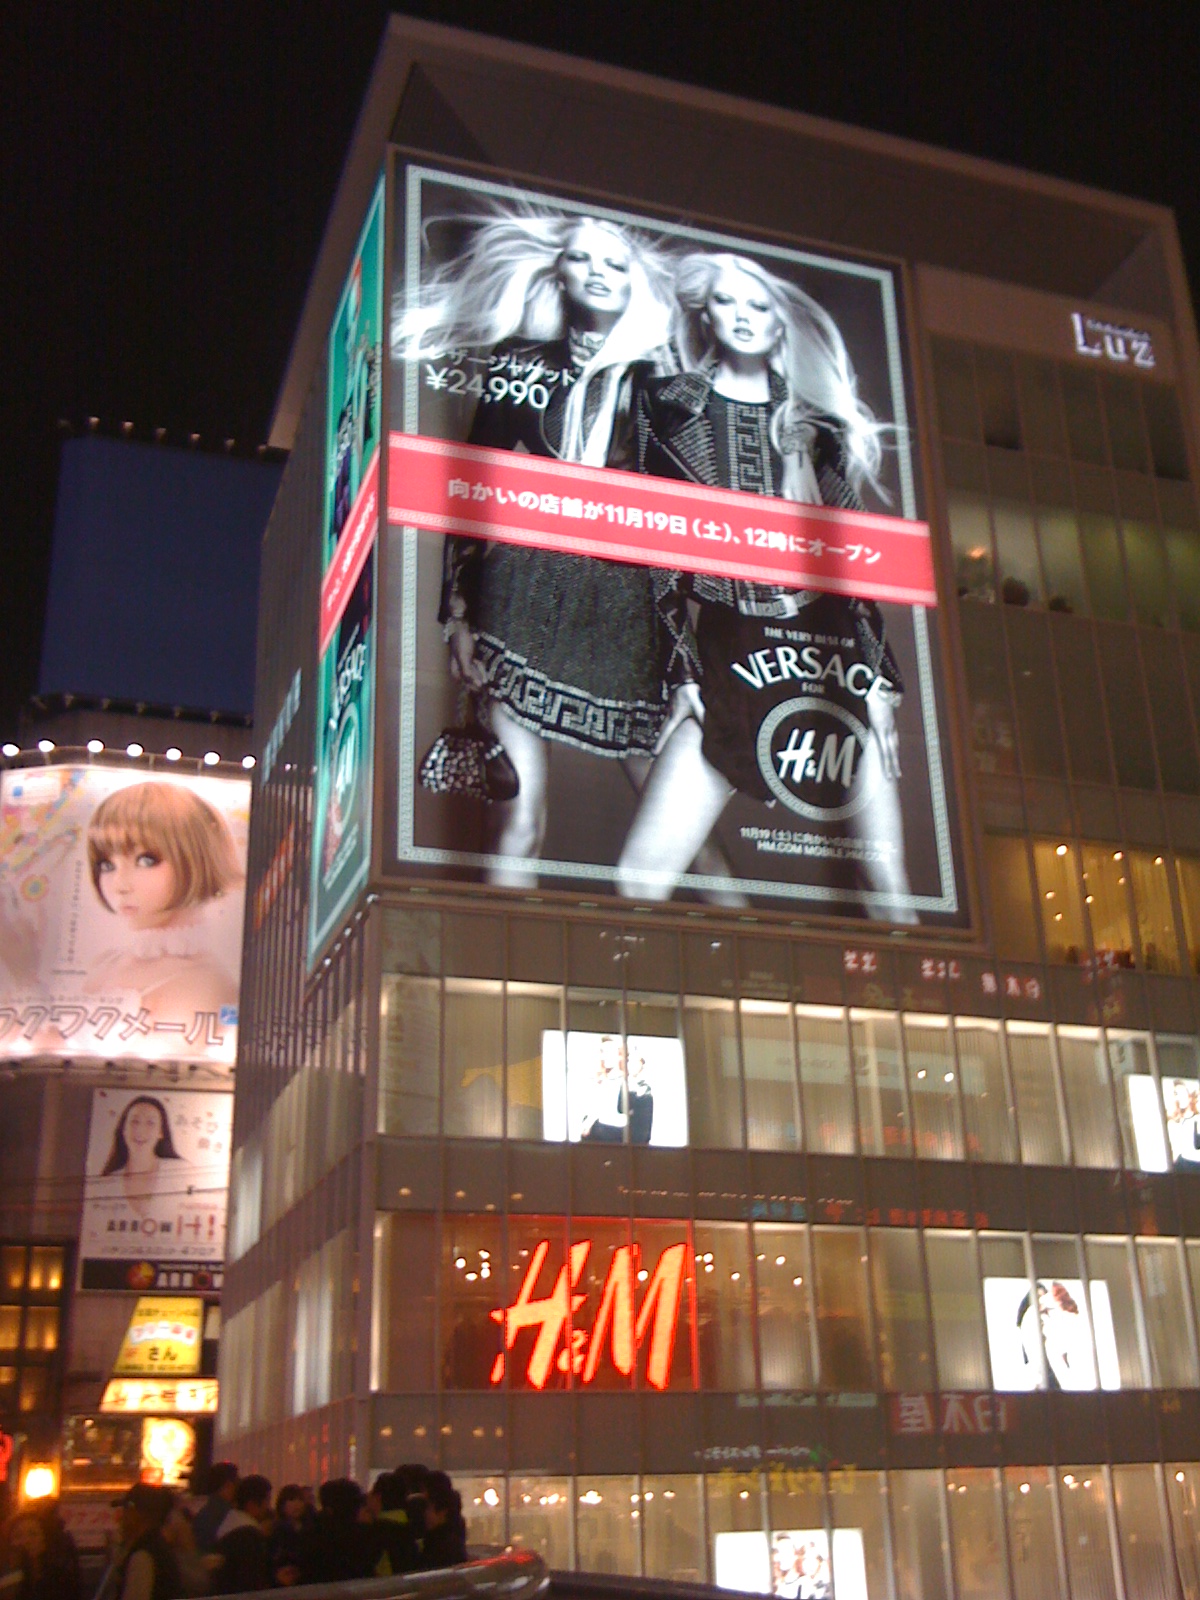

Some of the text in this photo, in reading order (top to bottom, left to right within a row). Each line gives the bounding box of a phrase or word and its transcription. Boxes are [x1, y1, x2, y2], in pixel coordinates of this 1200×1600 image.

[425, 363, 550, 409] ¥24,990
[731, 646, 894, 700] VERSACE
[776, 727, 857, 789] H&M
[489, 1238, 690, 1392] H&M
